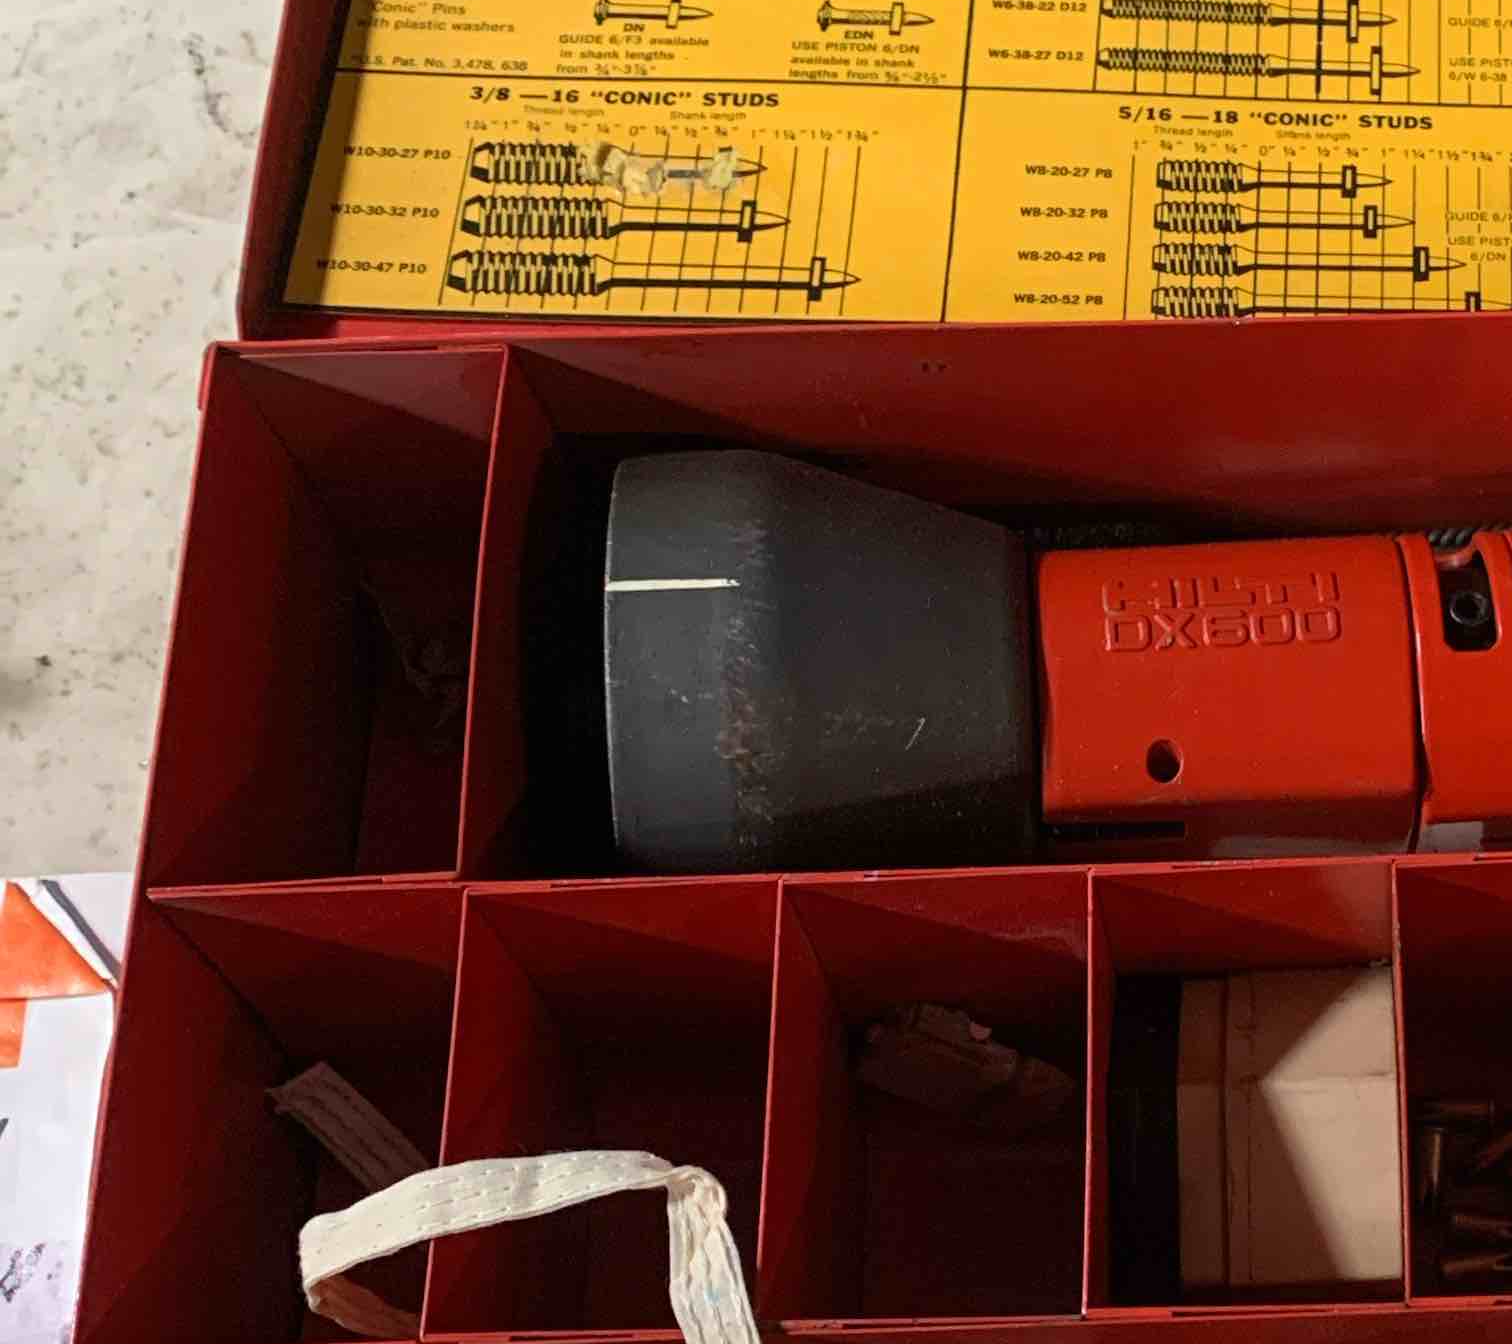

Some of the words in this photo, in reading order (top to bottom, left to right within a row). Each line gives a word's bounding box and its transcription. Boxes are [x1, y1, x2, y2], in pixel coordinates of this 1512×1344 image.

[394, 19, 446, 32] plastic
[451, 21, 515, 32] washers
[470, 87, 510, 103] 3/8
[552, 90, 579, 103] 16
[590, 90, 691, 106] "CONIC"
[703, 92, 779, 106] STUDS
[1119, 106, 1171, 124] 5/16
[1213, 110, 1238, 124] 18
[1250, 112, 1348, 128] "CONIC"
[1358, 114, 1433, 129] STUDS
[424, 149, 451, 160] P10
[411, 206, 440, 218] P10
[398, 262, 427, 275] P10
